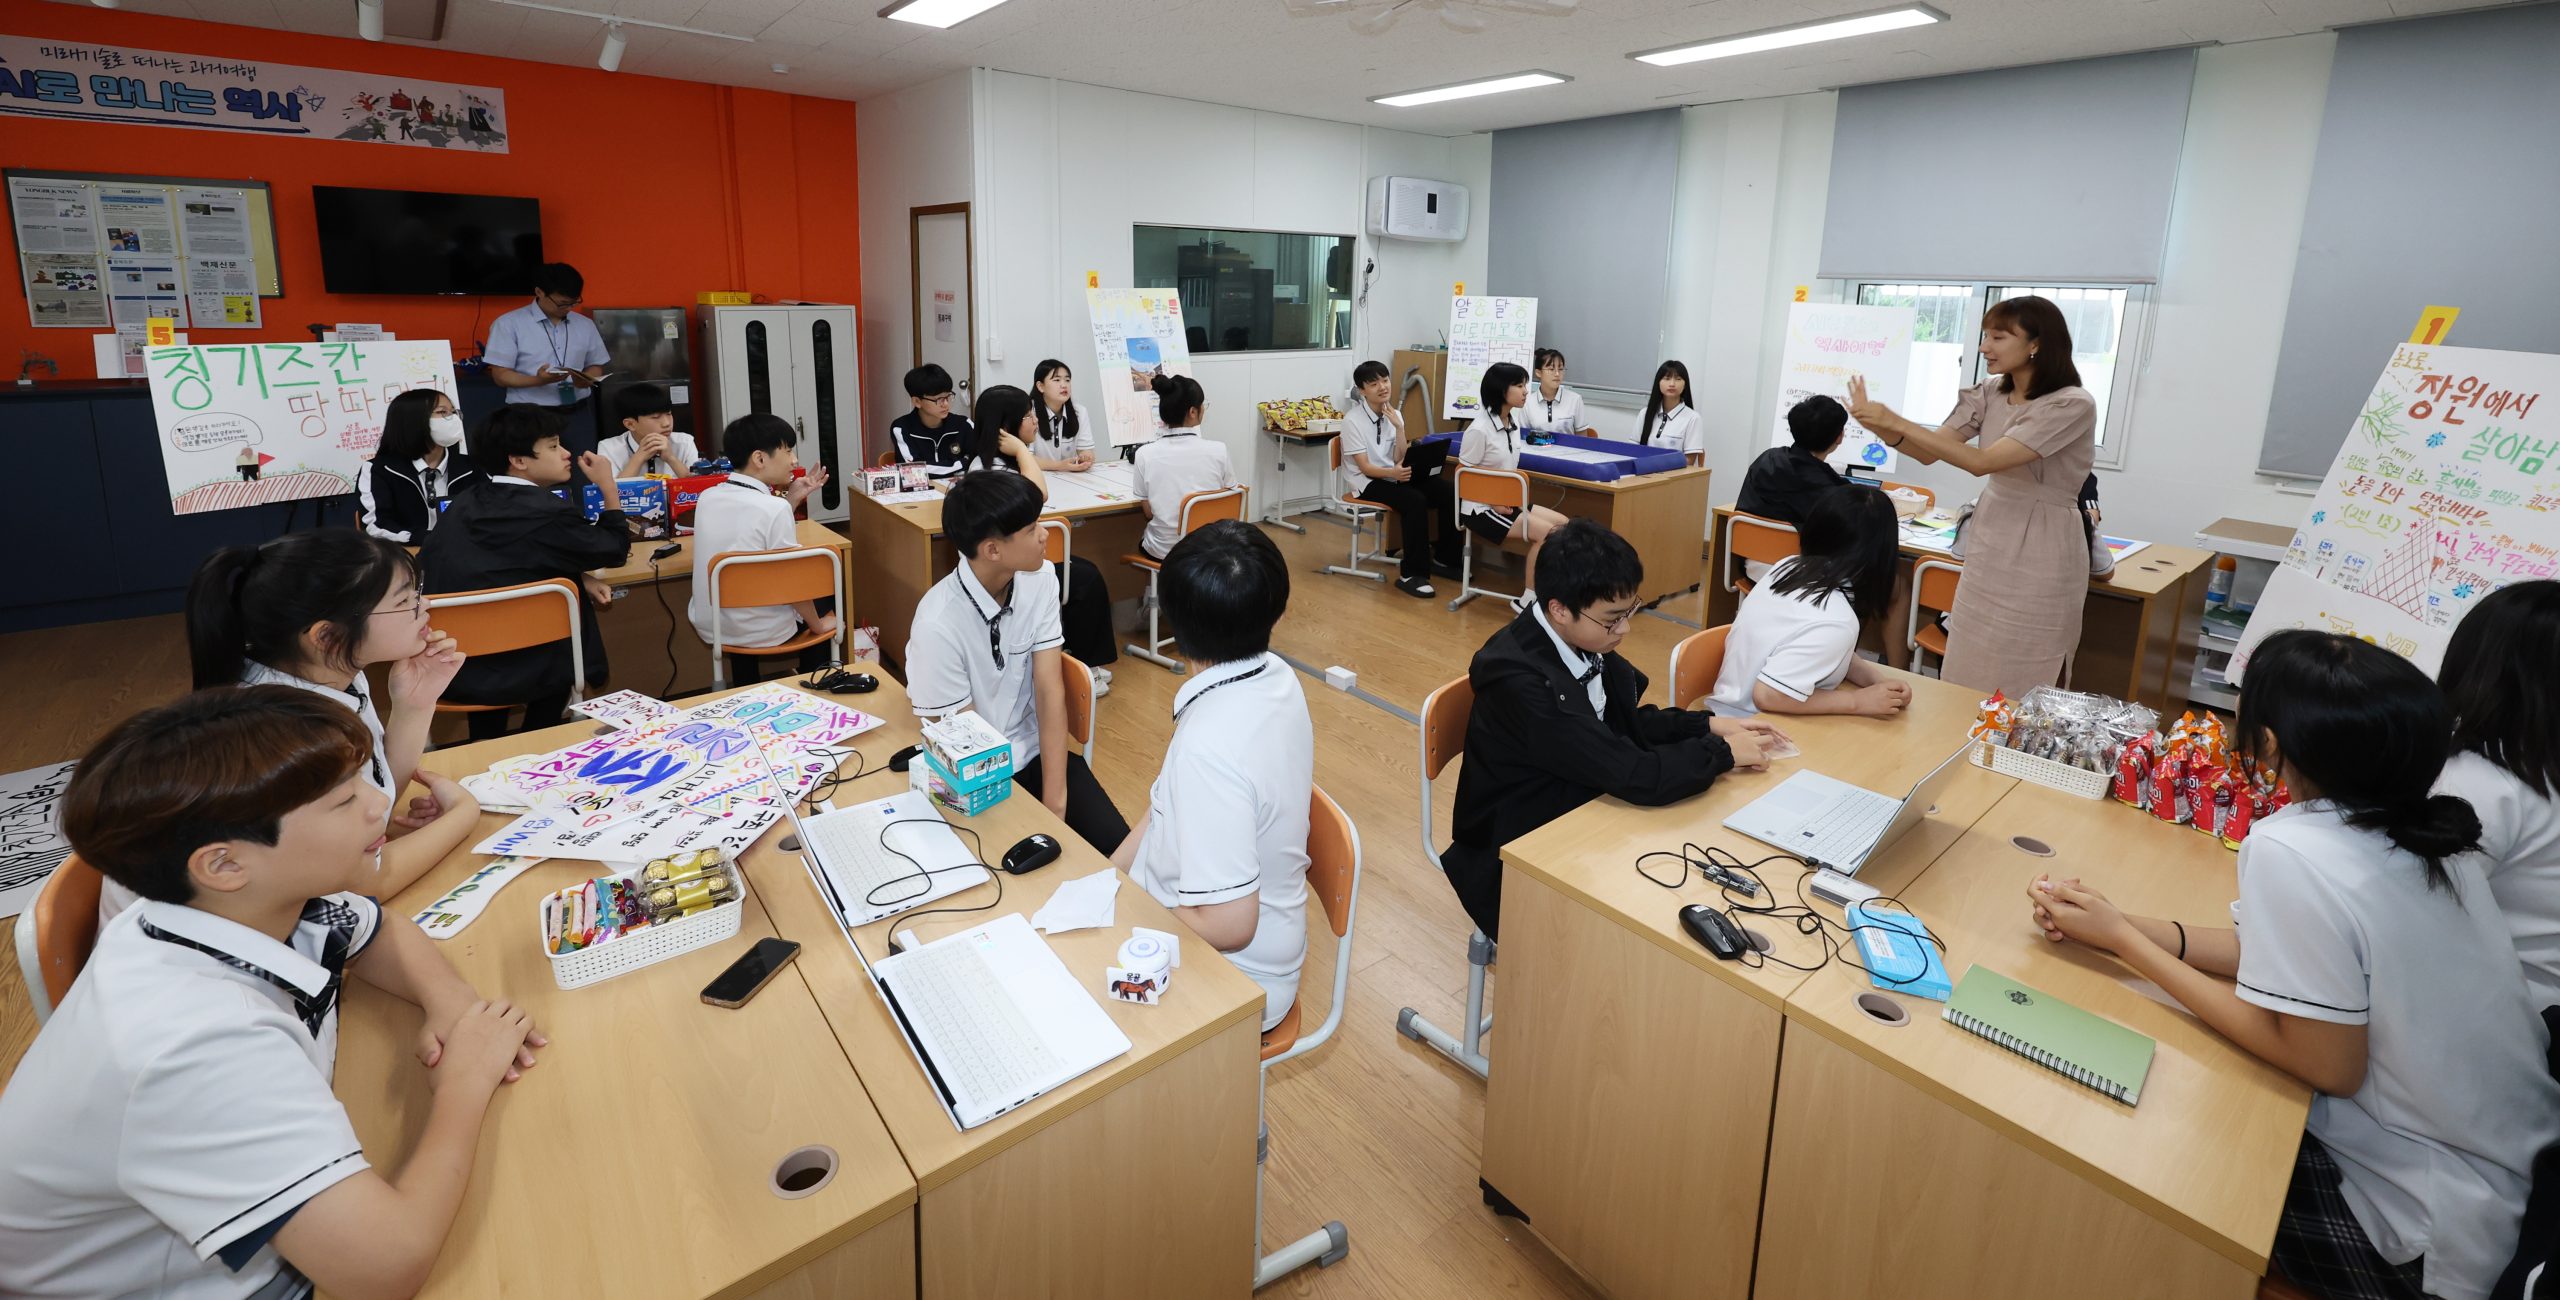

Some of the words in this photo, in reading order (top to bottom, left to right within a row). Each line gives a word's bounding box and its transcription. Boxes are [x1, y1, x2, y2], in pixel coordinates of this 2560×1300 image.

[40, 47, 126, 69] 미래기술로
[132, 54, 185, 73] 떠나는
[189, 60, 258, 82] 과거여행
[90, 74, 216, 115] 만나는
[223, 87, 303, 122] 역사
[1090, 276, 1098, 288] 4
[1455, 285, 1463, 295] 3
[1795, 290, 1806, 302] 2
[152, 327, 171, 345] 5
[2421, 317, 2445, 344] 1
[151, 343, 367, 411] 칭기즈칸
[2408, 373, 2540, 425] 장원에서
[2461, 426, 2560, 475] 살아남
[2376, 482, 2405, 503] 모아
